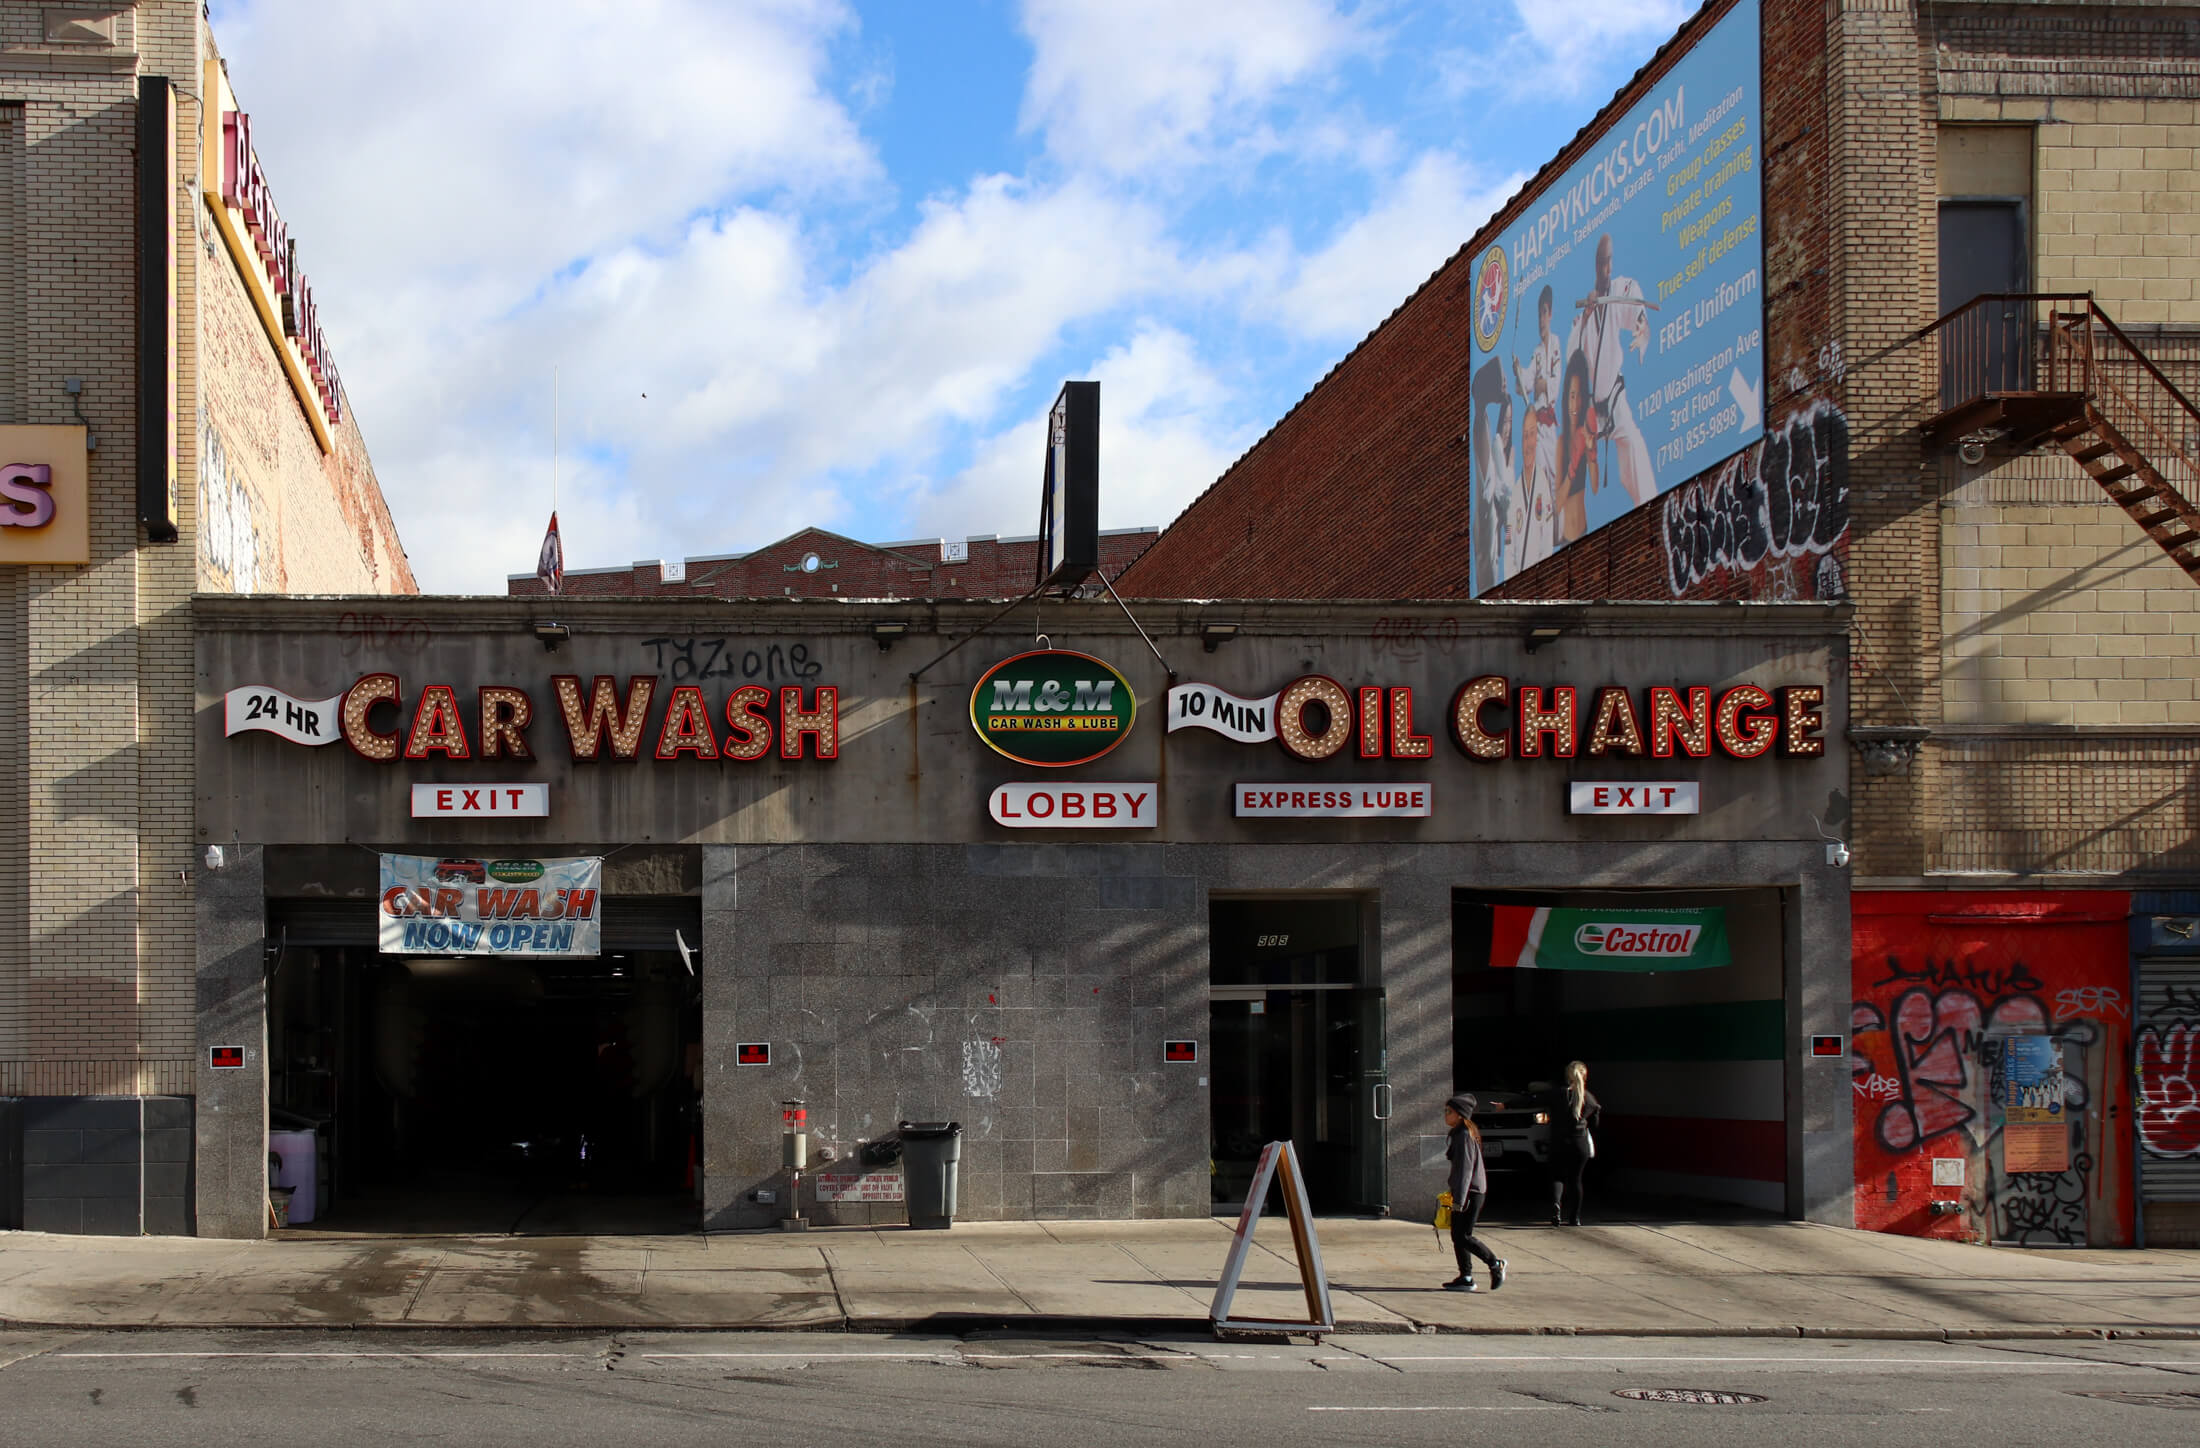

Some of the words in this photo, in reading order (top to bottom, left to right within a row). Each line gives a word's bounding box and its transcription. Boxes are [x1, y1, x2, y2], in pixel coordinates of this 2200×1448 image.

[1623, 168, 1655, 202] Karate,
[1688, 86, 1743, 145] Meditation
[1667, 156, 1701, 197] Group
[1704, 115, 1746, 166] classes
[1513, 85, 1685, 277] HAPPYKICKS.COM
[1662, 189, 1702, 233] Private
[1704, 144, 1753, 198] training
[1679, 195, 1733, 250] Weapons
[1657, 272, 1683, 302] True
[1685, 245, 1707, 282] self
[1708, 214, 1757, 265] defense
[1659, 309, 1692, 354] FREE
[1695, 268, 1757, 329] Uniform
[1637, 388, 1663, 421] 1120
[1663, 346, 1733, 403] Washington
[1735, 328, 1760, 359] Ave
[1669, 405, 1689, 432] 3rd
[1691, 385, 1723, 419] Floor
[1656, 434, 1685, 473] (718)
[1685, 403, 1738, 452] 855-9898
[245, 695, 279, 721] 24
[285, 700, 321, 737] HR
[338, 672, 536, 762] CAR
[550, 674, 840, 762] WASH
[990, 680, 1116, 712] M&M
[1179, 691, 1206, 718] 10
[1212, 695, 1266, 733] MIN
[1275, 674, 1433, 760] OIL
[1453, 675, 1824, 758] CHANGE
[991, 719, 1017, 729] CAR
[1023, 719, 1061, 729] WASH
[1068, 719, 1076, 729] &
[1083, 719, 1117, 729] LUBE
[436, 790, 524, 810] EXIT
[1001, 792, 1148, 818] LOBBY
[1243, 791, 1352, 808] EXPRESS
[1362, 791, 1424, 808] LUBE
[1594, 787, 1677, 808] EXIT
[382, 886, 464, 918] CAR
[477, 887, 598, 920] WASH
[404, 921, 483, 950] NOW
[488, 922, 574, 951] OPEN
[1257, 935, 1288, 946] 505
[1605, 927, 1691, 953] Castrol
